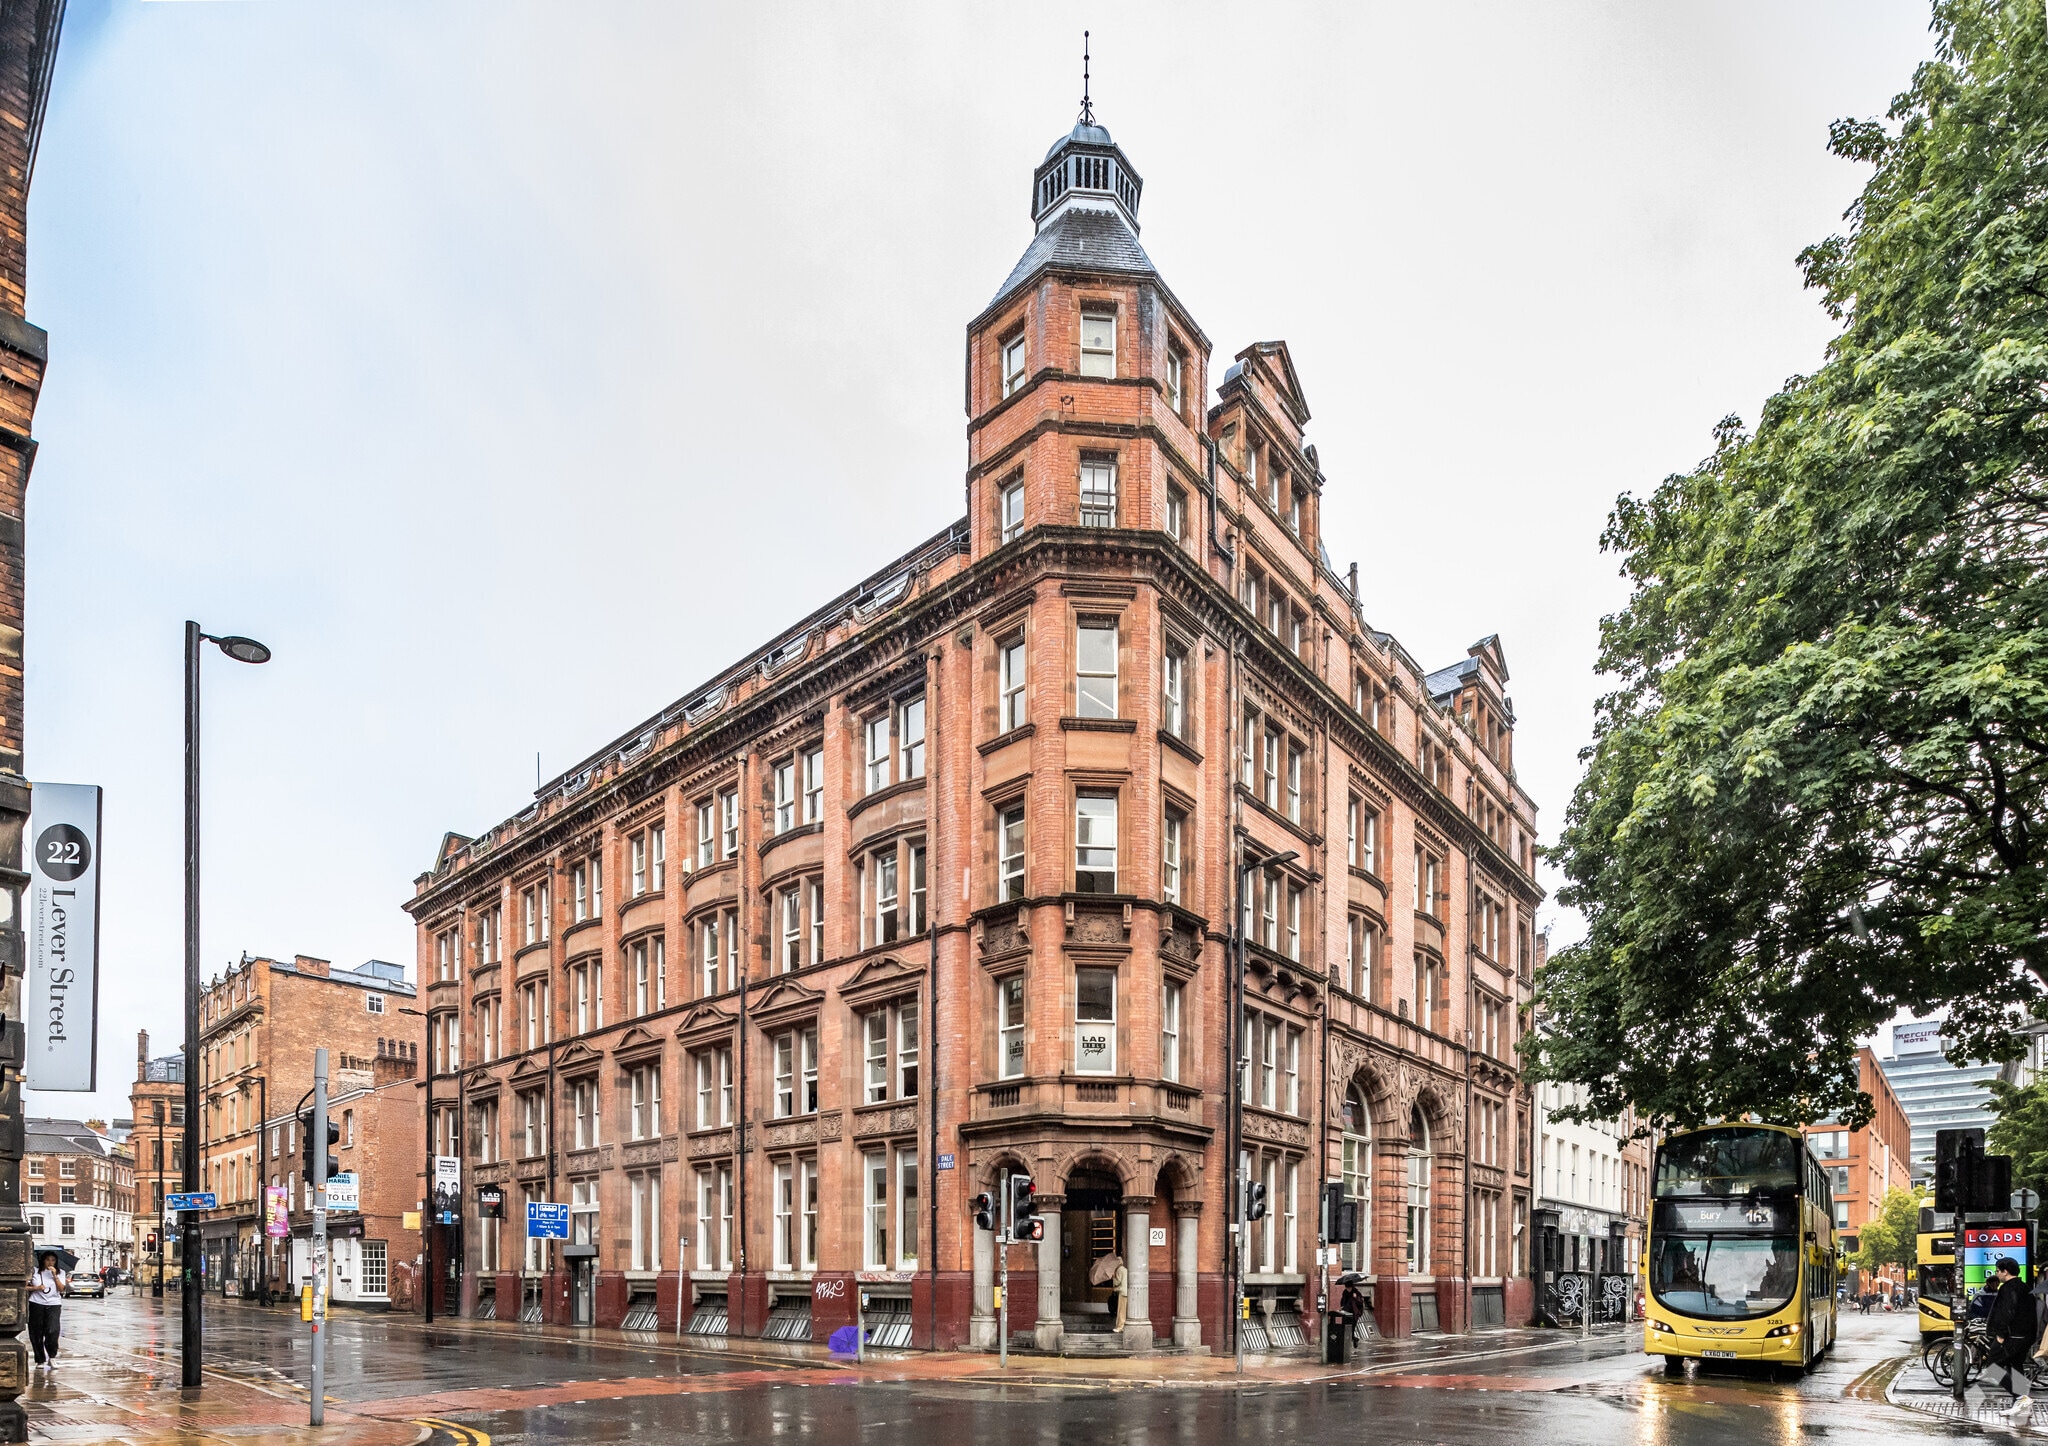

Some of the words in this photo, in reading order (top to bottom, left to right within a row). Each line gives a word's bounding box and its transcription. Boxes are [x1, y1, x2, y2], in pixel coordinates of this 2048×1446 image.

[46, 841, 80, 864] 22
[38, 887, 47, 969] 22leverstreet.com
[51, 886, 76, 962] Lever
[48, 968, 75, 1044] Street
[940, 1154, 953, 1162] DALE
[937, 1161, 954, 1169] STREET
[1700, 1210, 1721, 1220] Bury
[1745, 1209, 1772, 1223] 163
[1152, 1231, 1164, 1239] 20
[1968, 1233, 2022, 1242] LOADS
[1984, 1252, 2005, 1261] TO
